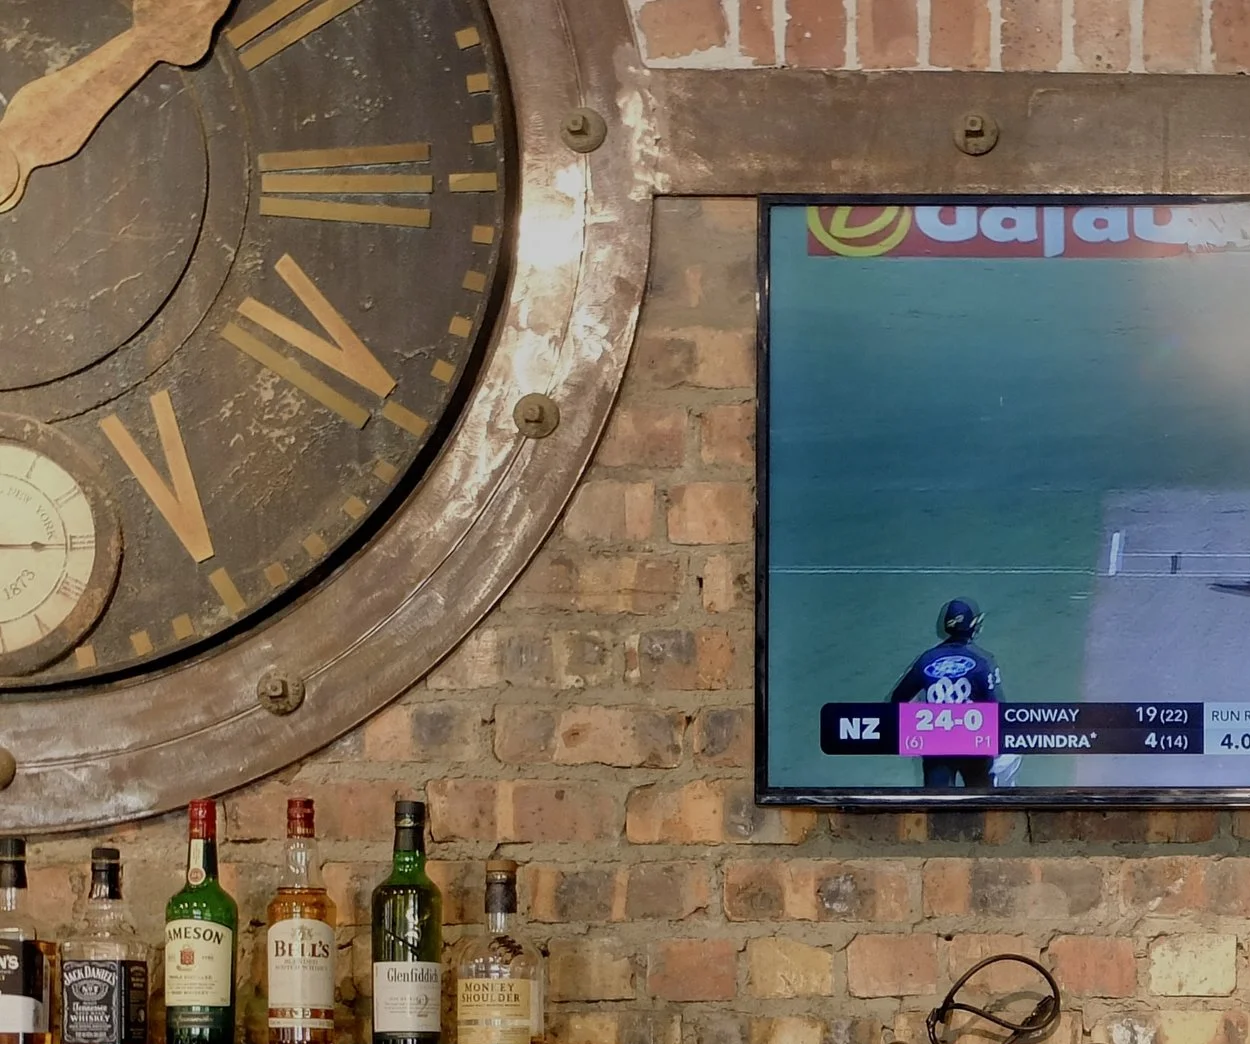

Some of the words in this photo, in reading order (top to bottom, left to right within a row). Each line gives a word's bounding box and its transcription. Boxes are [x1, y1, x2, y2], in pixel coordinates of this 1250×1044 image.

[36, 505, 55, 540] YORK
[916, 709, 983, 731] 24-0
[1004, 708, 1079, 723] CONWAY
[1136, 707, 1157, 722] 19
[1160, 709, 1188, 724] (22)
[1211, 710, 1241, 722] RUN
[839, 718, 880, 740] NZ
[905, 735, 924, 750] (6)
[975, 735, 992, 748] P1
[1145, 733, 1157, 748] 4
[1160, 735, 1188, 750] (14)
[166, 927, 223, 945] AMESON
[63, 967, 84, 986] JACK
[84, 965, 118, 986] DANIEL'S
